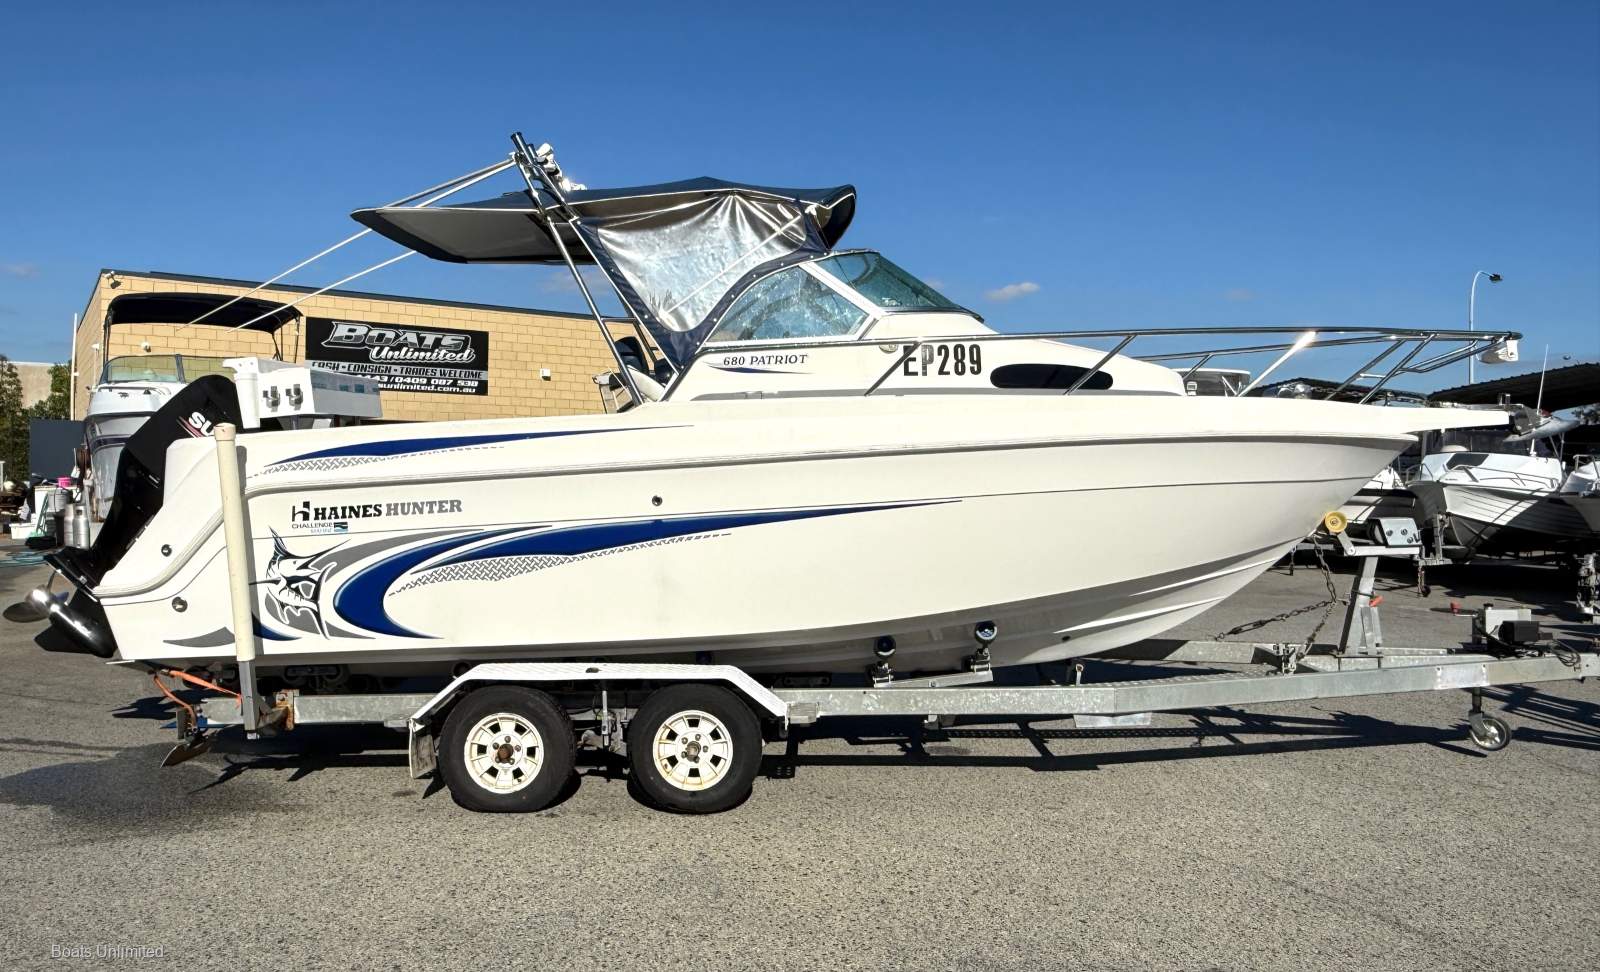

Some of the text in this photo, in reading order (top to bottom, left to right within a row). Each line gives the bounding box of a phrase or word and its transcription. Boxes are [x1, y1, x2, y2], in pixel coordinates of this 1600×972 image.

[323, 321, 470, 350] BOATS
[370, 346, 475, 362] Unlimited
[723, 354, 809, 366] 680 PATRIOT
[903, 343, 982, 377] EP289
[347, 363, 392, 374] CONSIGN
[400, 366, 437, 377] TRADES
[439, 369, 483, 379] WELCOME
[377, 382, 476, 393] sunlimited.com.au
[313, 503, 383, 521] HAINES
[385, 499, 463, 517] HUNTER
